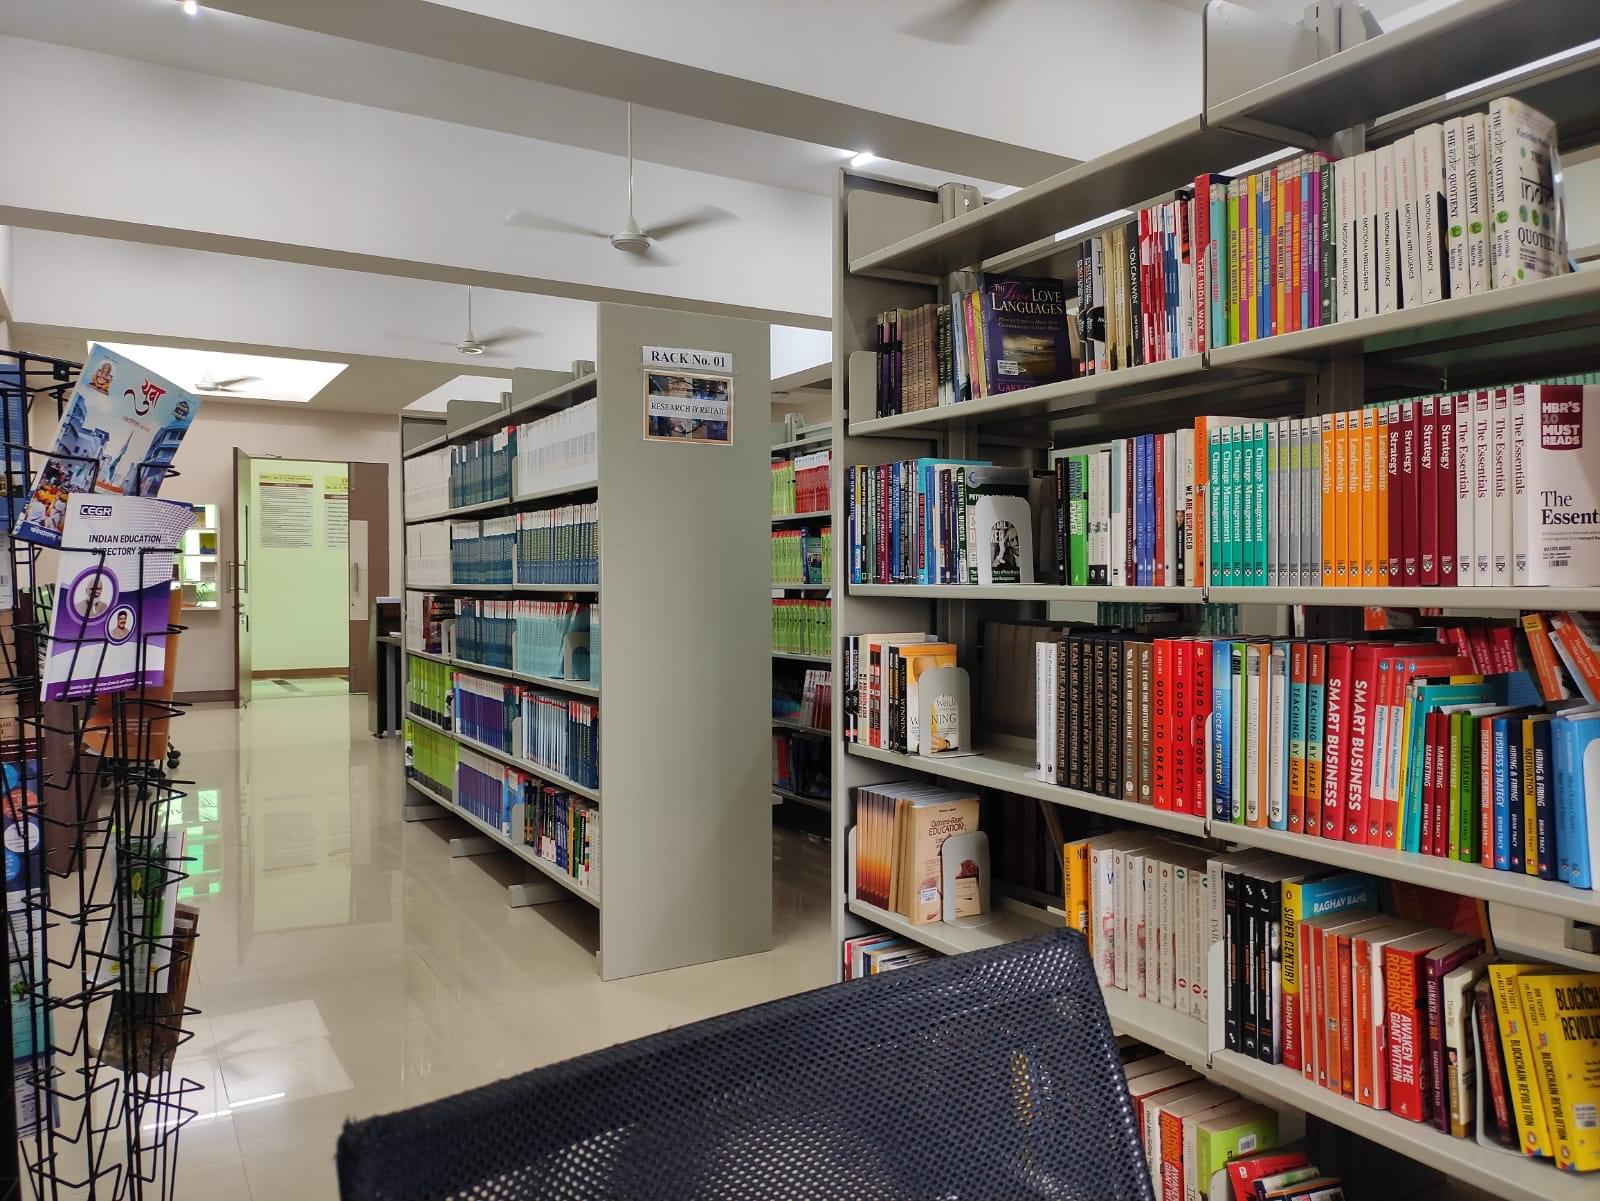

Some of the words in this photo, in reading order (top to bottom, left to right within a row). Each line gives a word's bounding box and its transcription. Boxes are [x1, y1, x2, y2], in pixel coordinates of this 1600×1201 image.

[1466, 125, 1475, 142] THE
[1492, 110, 1502, 130] THE
[1466, 169, 1478, 215] QUOTIENT
[1493, 156, 1504, 204] QUOTIENT
[991, 292, 1062, 315] LANGUAGES
[1032, 288, 1061, 302] LOVE
[651, 351, 688, 364] RACK
[692, 355, 710, 366] No.
[714, 357, 725, 367] 01
[651, 403, 691, 412] RESEARCH
[1542, 401, 1581, 414] HBR'S
[1543, 414, 1558, 424] 10
[1459, 422, 1468, 442] The
[1478, 419, 1488, 441] The
[1496, 417, 1505, 439] The
[1514, 414, 1524, 436] The
[1542, 424, 1580, 435] MUST
[1542, 436, 1580, 446] READS
[1389, 432, 1399, 476] Strategy
[1404, 430, 1413, 474] Strategy
[1422, 424, 1433, 469] Strategy
[1440, 424, 1451, 470] Strategy
[1336, 438, 1344, 493] Leadership
[1349, 438, 1358, 493] Leadership
[1364, 436, 1373, 492] Leadership
[1459, 444, 1469, 499] Essentials
[1478, 446, 1488, 498] Essentials
[1496, 442, 1505, 497] Essentials
[1515, 437, 1525, 495] Essentials
[1186, 486, 1192, 497] WE
[1541, 490, 1572, 506] The
[81, 506, 111, 515] CEGR
[1096, 693, 1103, 706] AN
[1110, 693, 1117, 706] AN
[1142, 682, 1149, 690] ON
[1328, 678, 1341, 732] SMART
[1352, 680, 1367, 734] SMART
[1157, 723, 1163, 739] TO
[1176, 726, 1183, 742] TO
[1376, 707, 1385, 746] Performance
[1292, 743, 1299, 755] BY
[1309, 746, 1316, 758] BY
[1495, 732, 1504, 767] BUSINESS
[1509, 745, 1517, 769] HIRING
[1325, 735, 1339, 807] BUSINESS
[1348, 737, 1364, 811] BUSINESS
[1375, 748, 1383, 787] Management
[1525, 748, 1534, 796] MOTIVATION
[1496, 769, 1504, 807] STRATEGY
[929, 824, 963, 836] EDUCATION
[1313, 899, 1346, 913] RAGHAV
[1347, 895, 1367, 907] BAHL
[1284, 908, 1294, 938] SUPER
[1284, 940, 1295, 984] CENTURY
[1386, 953, 1401, 1011] ROBBINS
[1399, 956, 1412, 1015] ANTHONY
[1428, 980, 1437, 1013] CHANAKYA
[1390, 1012, 1401, 1041] GIANT
[1401, 1014, 1413, 1061] AWAKEN
[1392, 1044, 1403, 1083] WITHIN
[1402, 1064, 1413, 1085] THE
[1510, 1040, 1525, 1082] BLOCKCHAIN
[1517, 1084, 1534, 1127] REVOLUTION
[1541, 1052, 1557, 1095] BLOCKCHAIN
[1551, 1097, 1568, 1141] REVOLUTION
